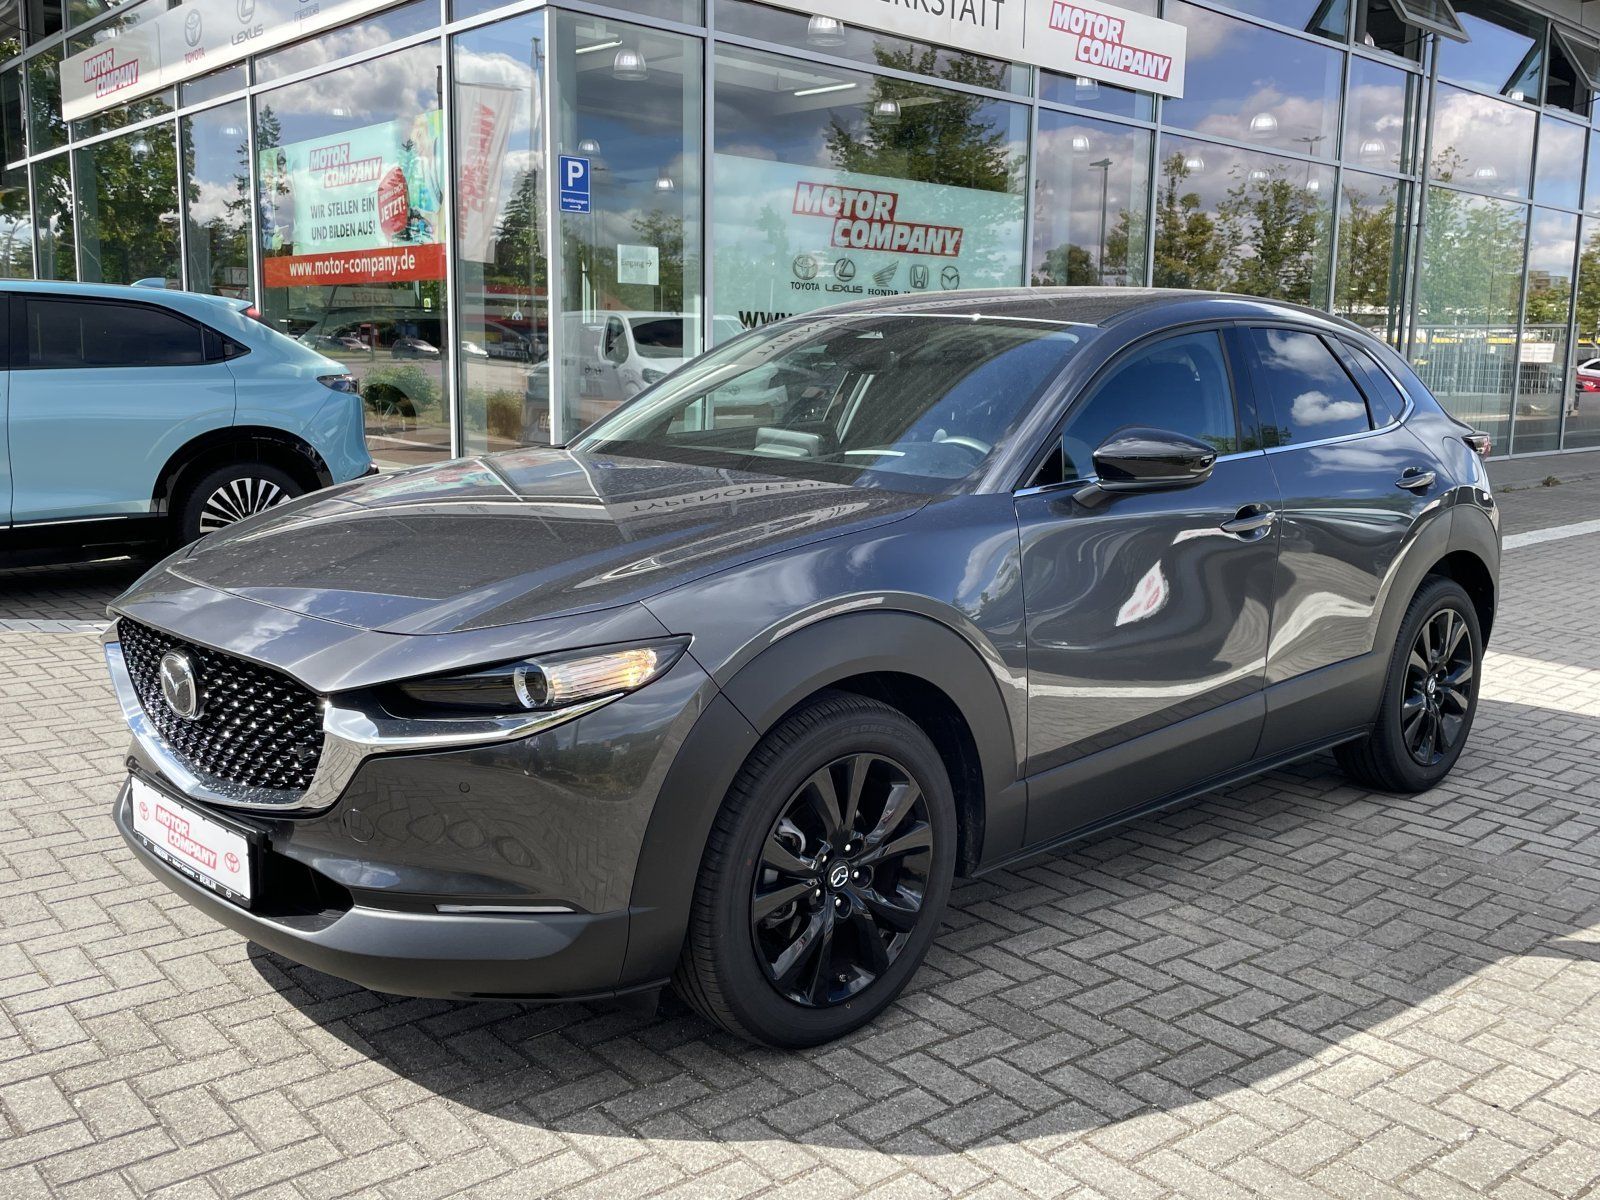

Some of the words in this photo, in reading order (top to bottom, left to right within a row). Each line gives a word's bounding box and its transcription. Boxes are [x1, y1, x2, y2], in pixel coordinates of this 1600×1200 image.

[231, 24, 264, 46] LEXUS
[1051, 3, 1123, 43] MOTOR
[84, 48, 113, 82] MOTOR
[184, 47, 206, 64] TOYOTA
[1077, 36, 1171, 81] COMPANY
[96, 60, 138, 97] COMPANY
[310, 144, 350, 171] MOTOR
[324, 158, 382, 188] COMPANY
[567, 160, 584, 187] P
[310, 204, 326, 220] WIR
[327, 199, 359, 219] STELLEN
[361, 196, 376, 213] EIN
[381, 195, 406, 223] JETZT!
[795, 183, 895, 222] MOTOR
[311, 226, 328, 241] UND
[328, 222, 356, 239] BILDEN
[357, 220, 376, 236] AUS!
[832, 217, 961, 255] COMPANY
[289, 249, 416, 277] www.motor-company.de
[790, 281, 820, 292] TOYOTA
[825, 284, 864, 294] LEXUS
[156, 805, 189, 837] MOTOR
[168, 829, 217, 869] COMPANY
